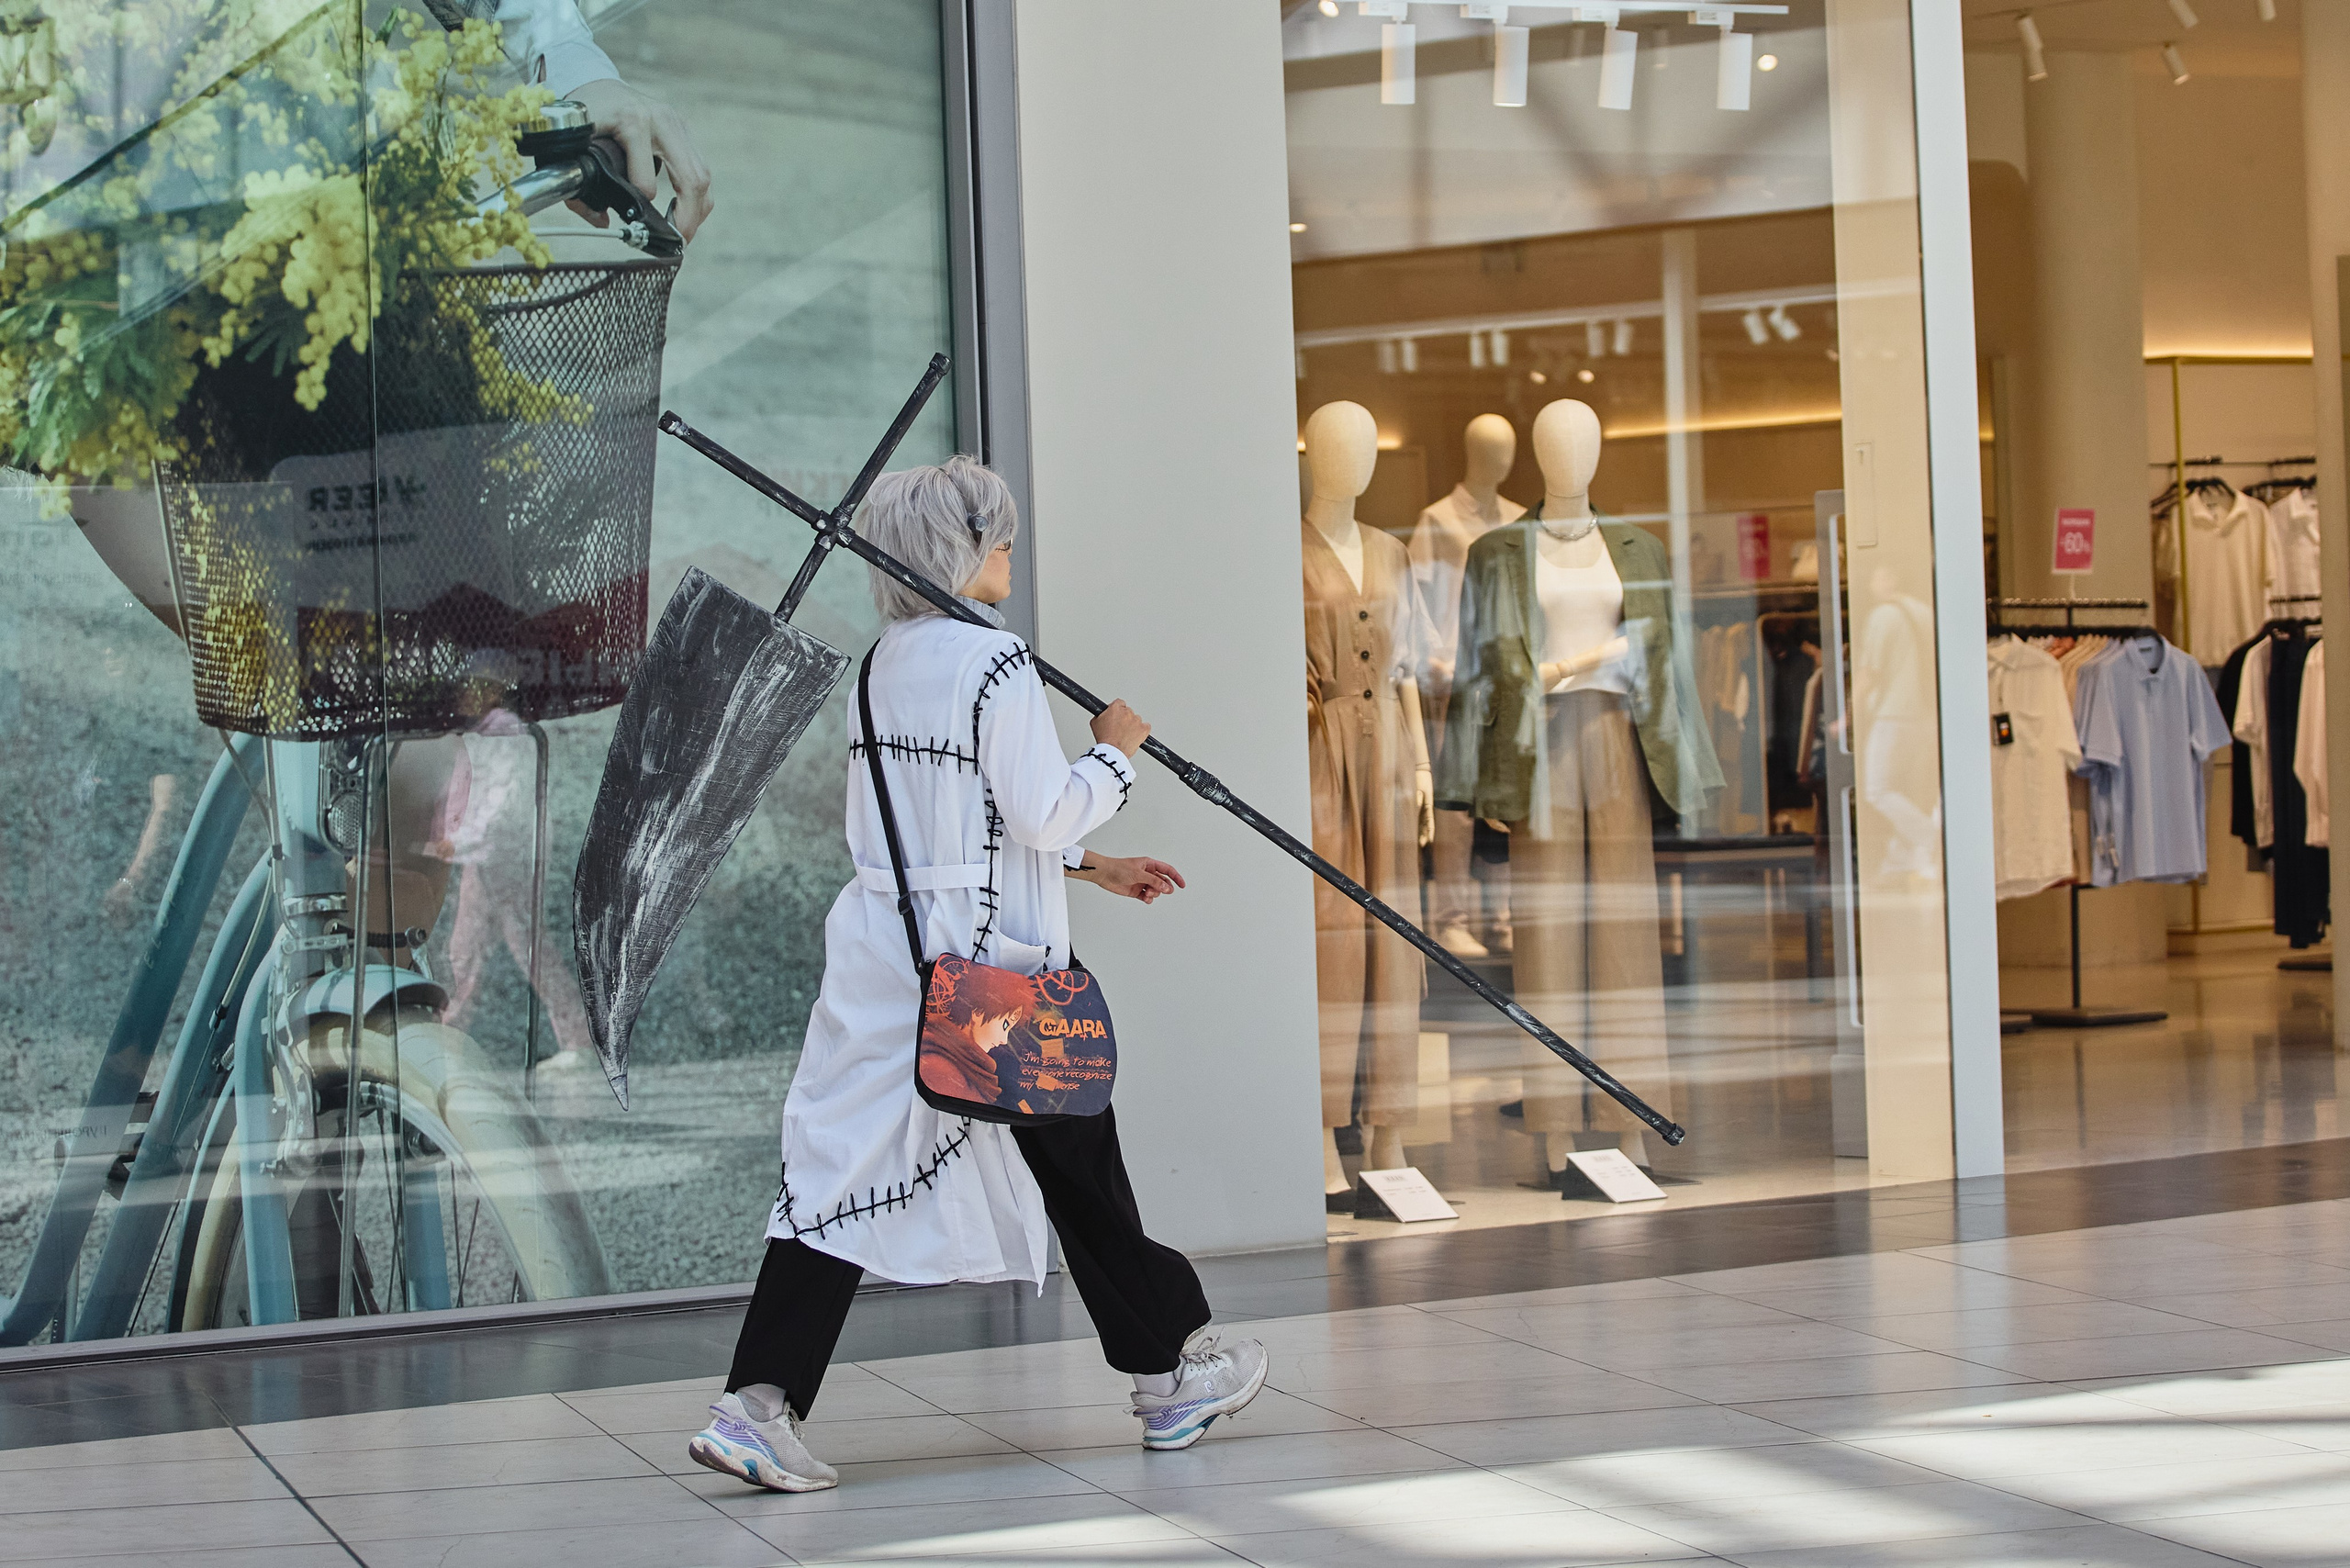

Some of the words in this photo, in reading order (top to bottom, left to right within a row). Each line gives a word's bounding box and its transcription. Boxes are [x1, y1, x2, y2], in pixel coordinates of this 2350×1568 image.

[1039, 1018, 1108, 1039] GAARA
[1073, 1057, 1084, 1066] to
[1086, 1057, 1112, 1068] make
[1065, 1071, 1113, 1081] recognize
[1020, 1081, 1035, 1091] my
